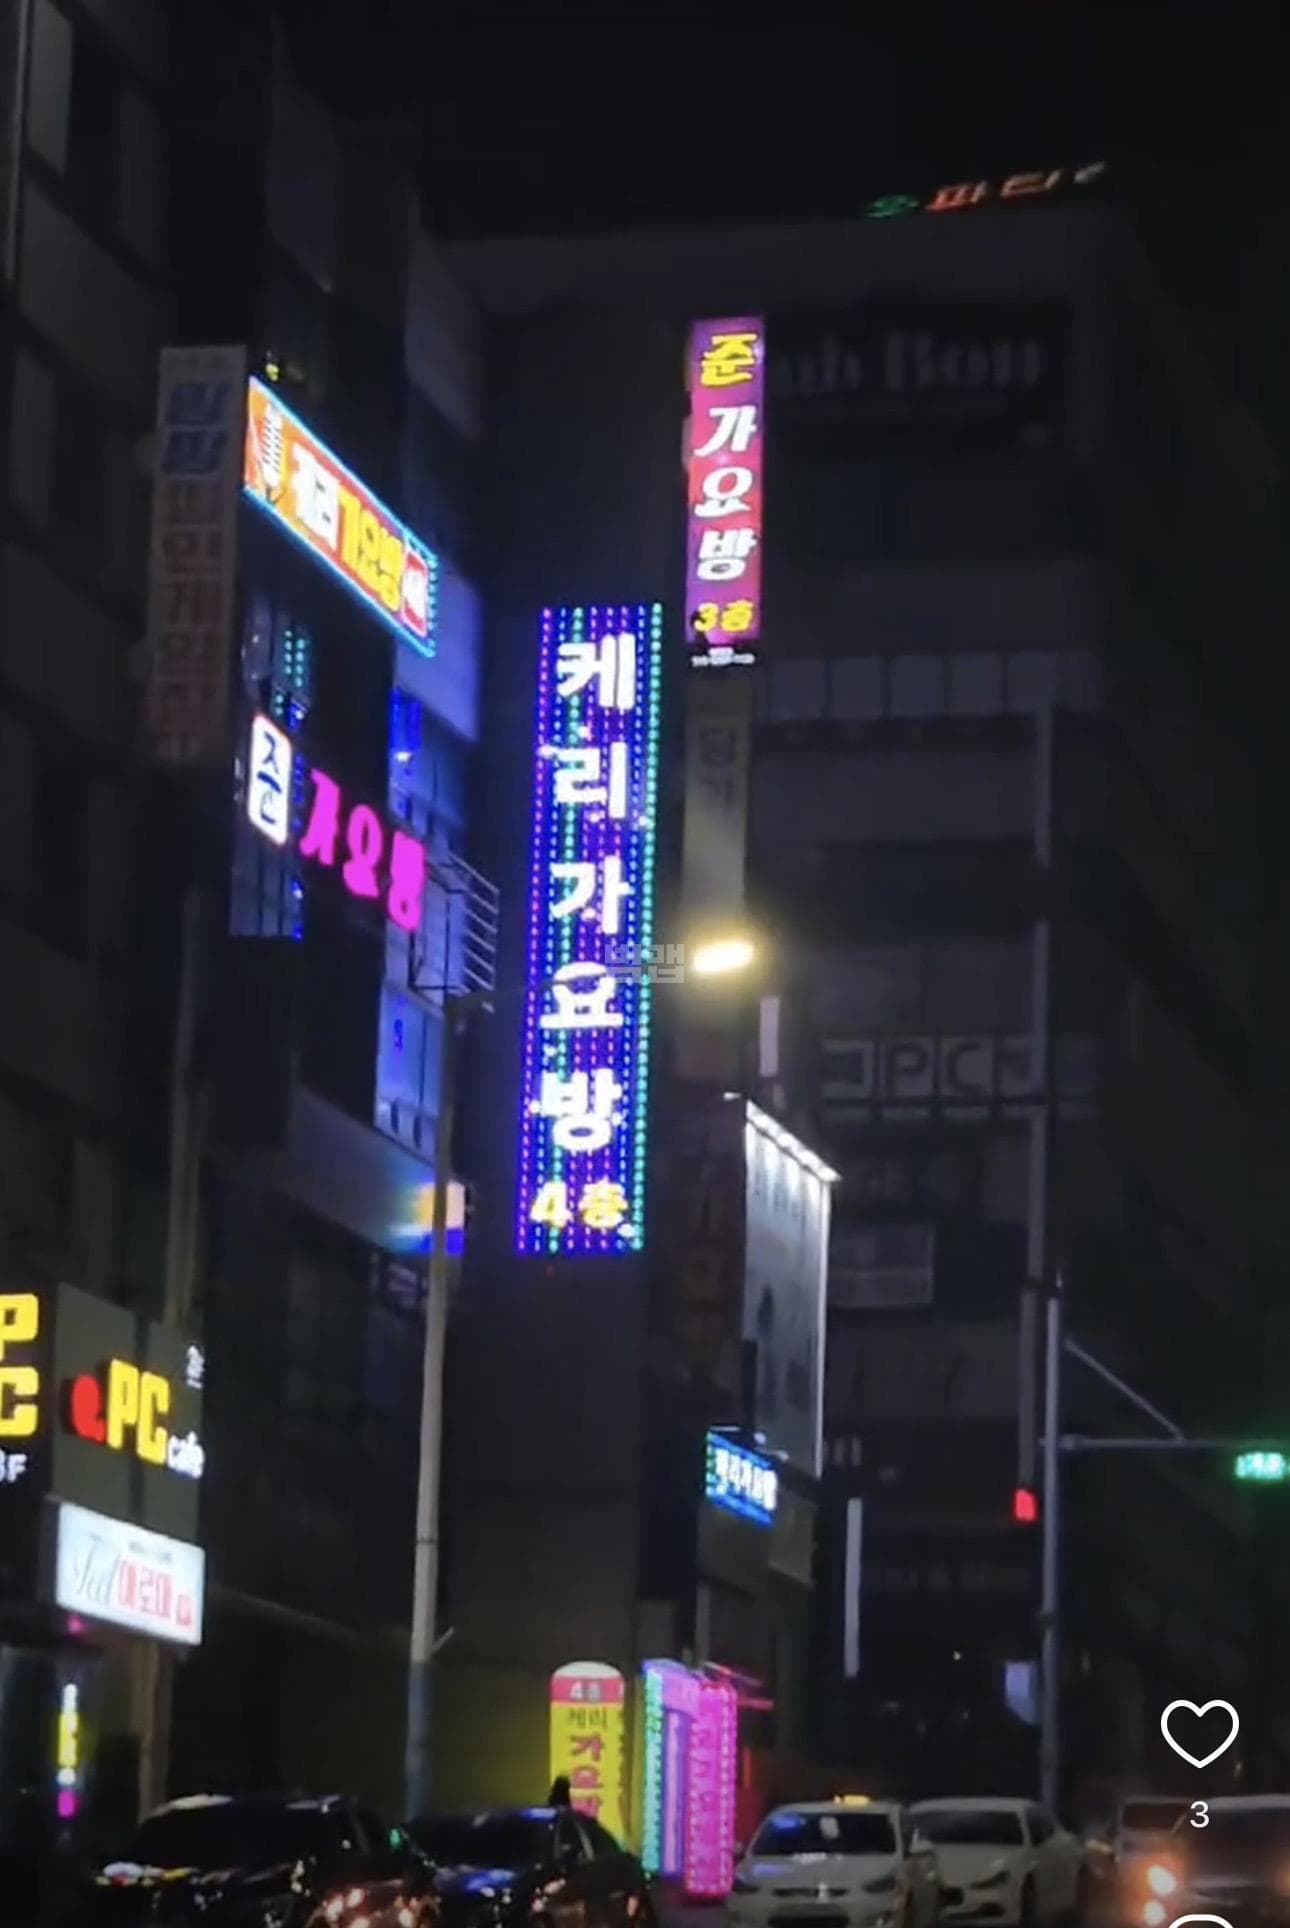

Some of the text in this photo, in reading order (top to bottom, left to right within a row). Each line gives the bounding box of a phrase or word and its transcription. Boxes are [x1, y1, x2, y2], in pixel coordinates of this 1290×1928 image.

[700, 332, 757, 387] 준
[693, 405, 758, 581] 가요방
[530, 632, 636, 1228] 케리가요방 4층
